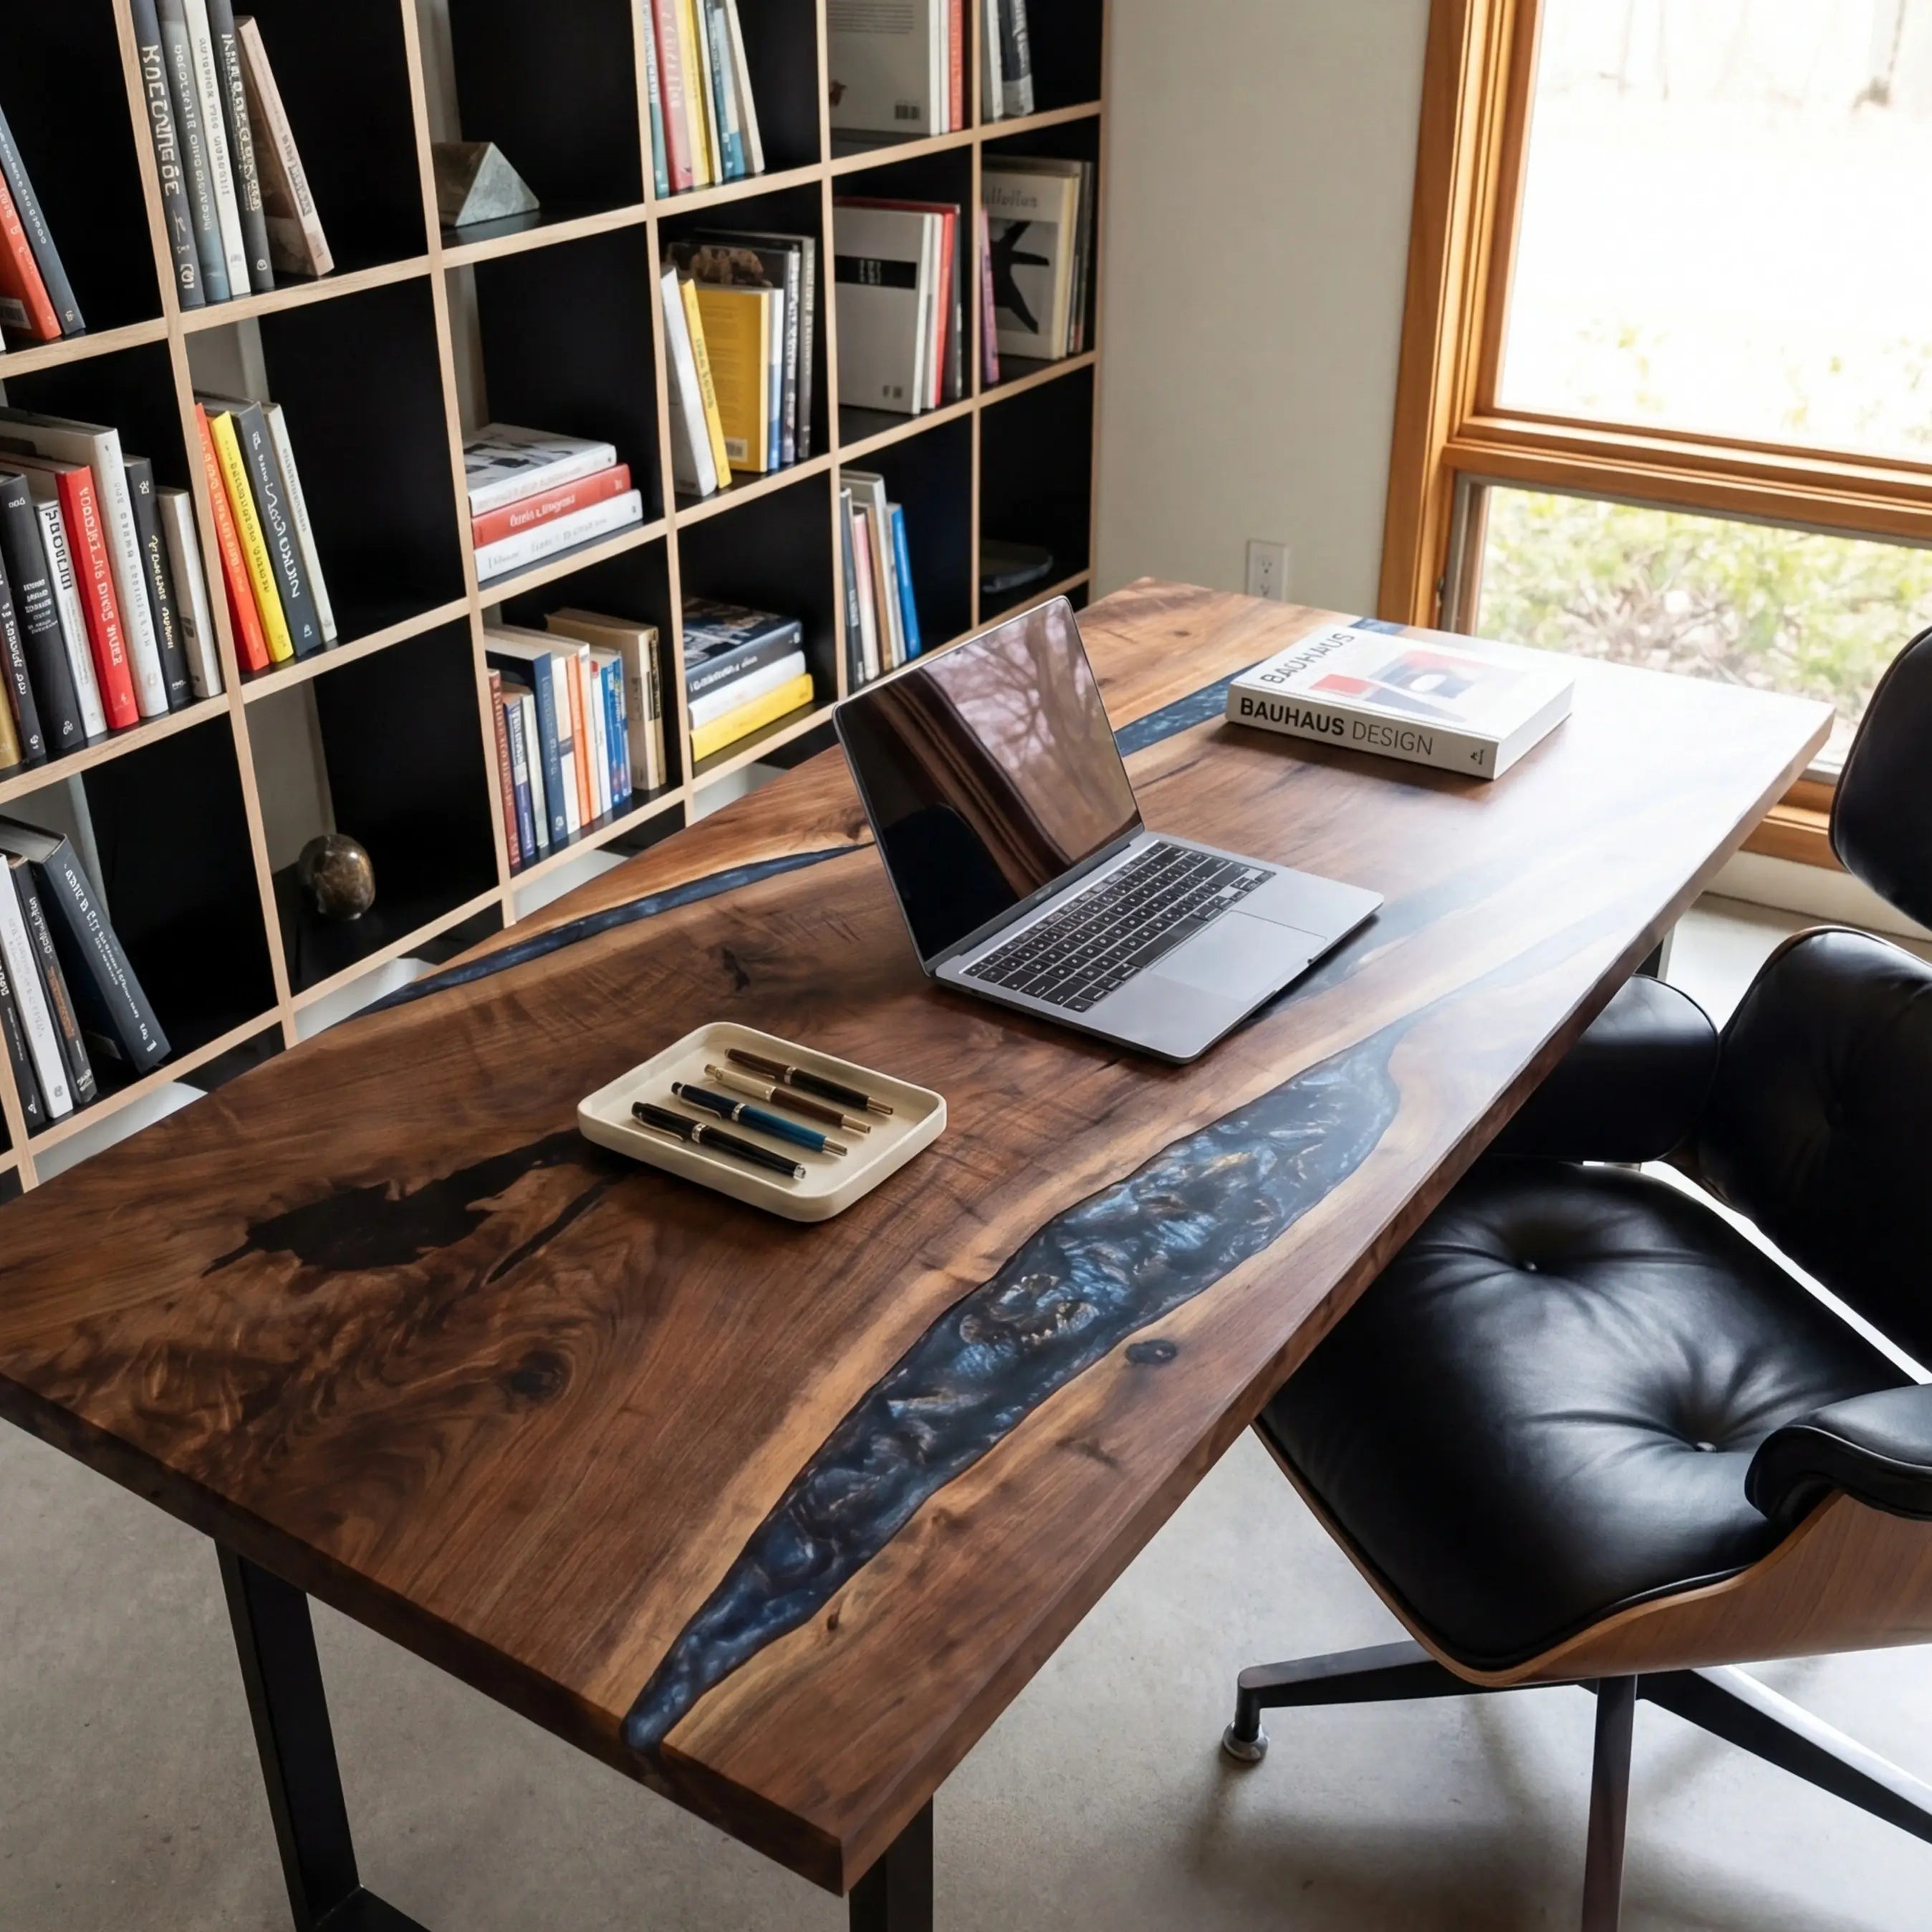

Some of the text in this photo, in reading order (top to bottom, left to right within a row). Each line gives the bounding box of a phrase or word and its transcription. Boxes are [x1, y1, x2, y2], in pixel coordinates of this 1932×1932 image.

[1260, 633, 1355, 684] BAUHAUS
[1240, 697, 1433, 755] BAUHAUS DESIGN
